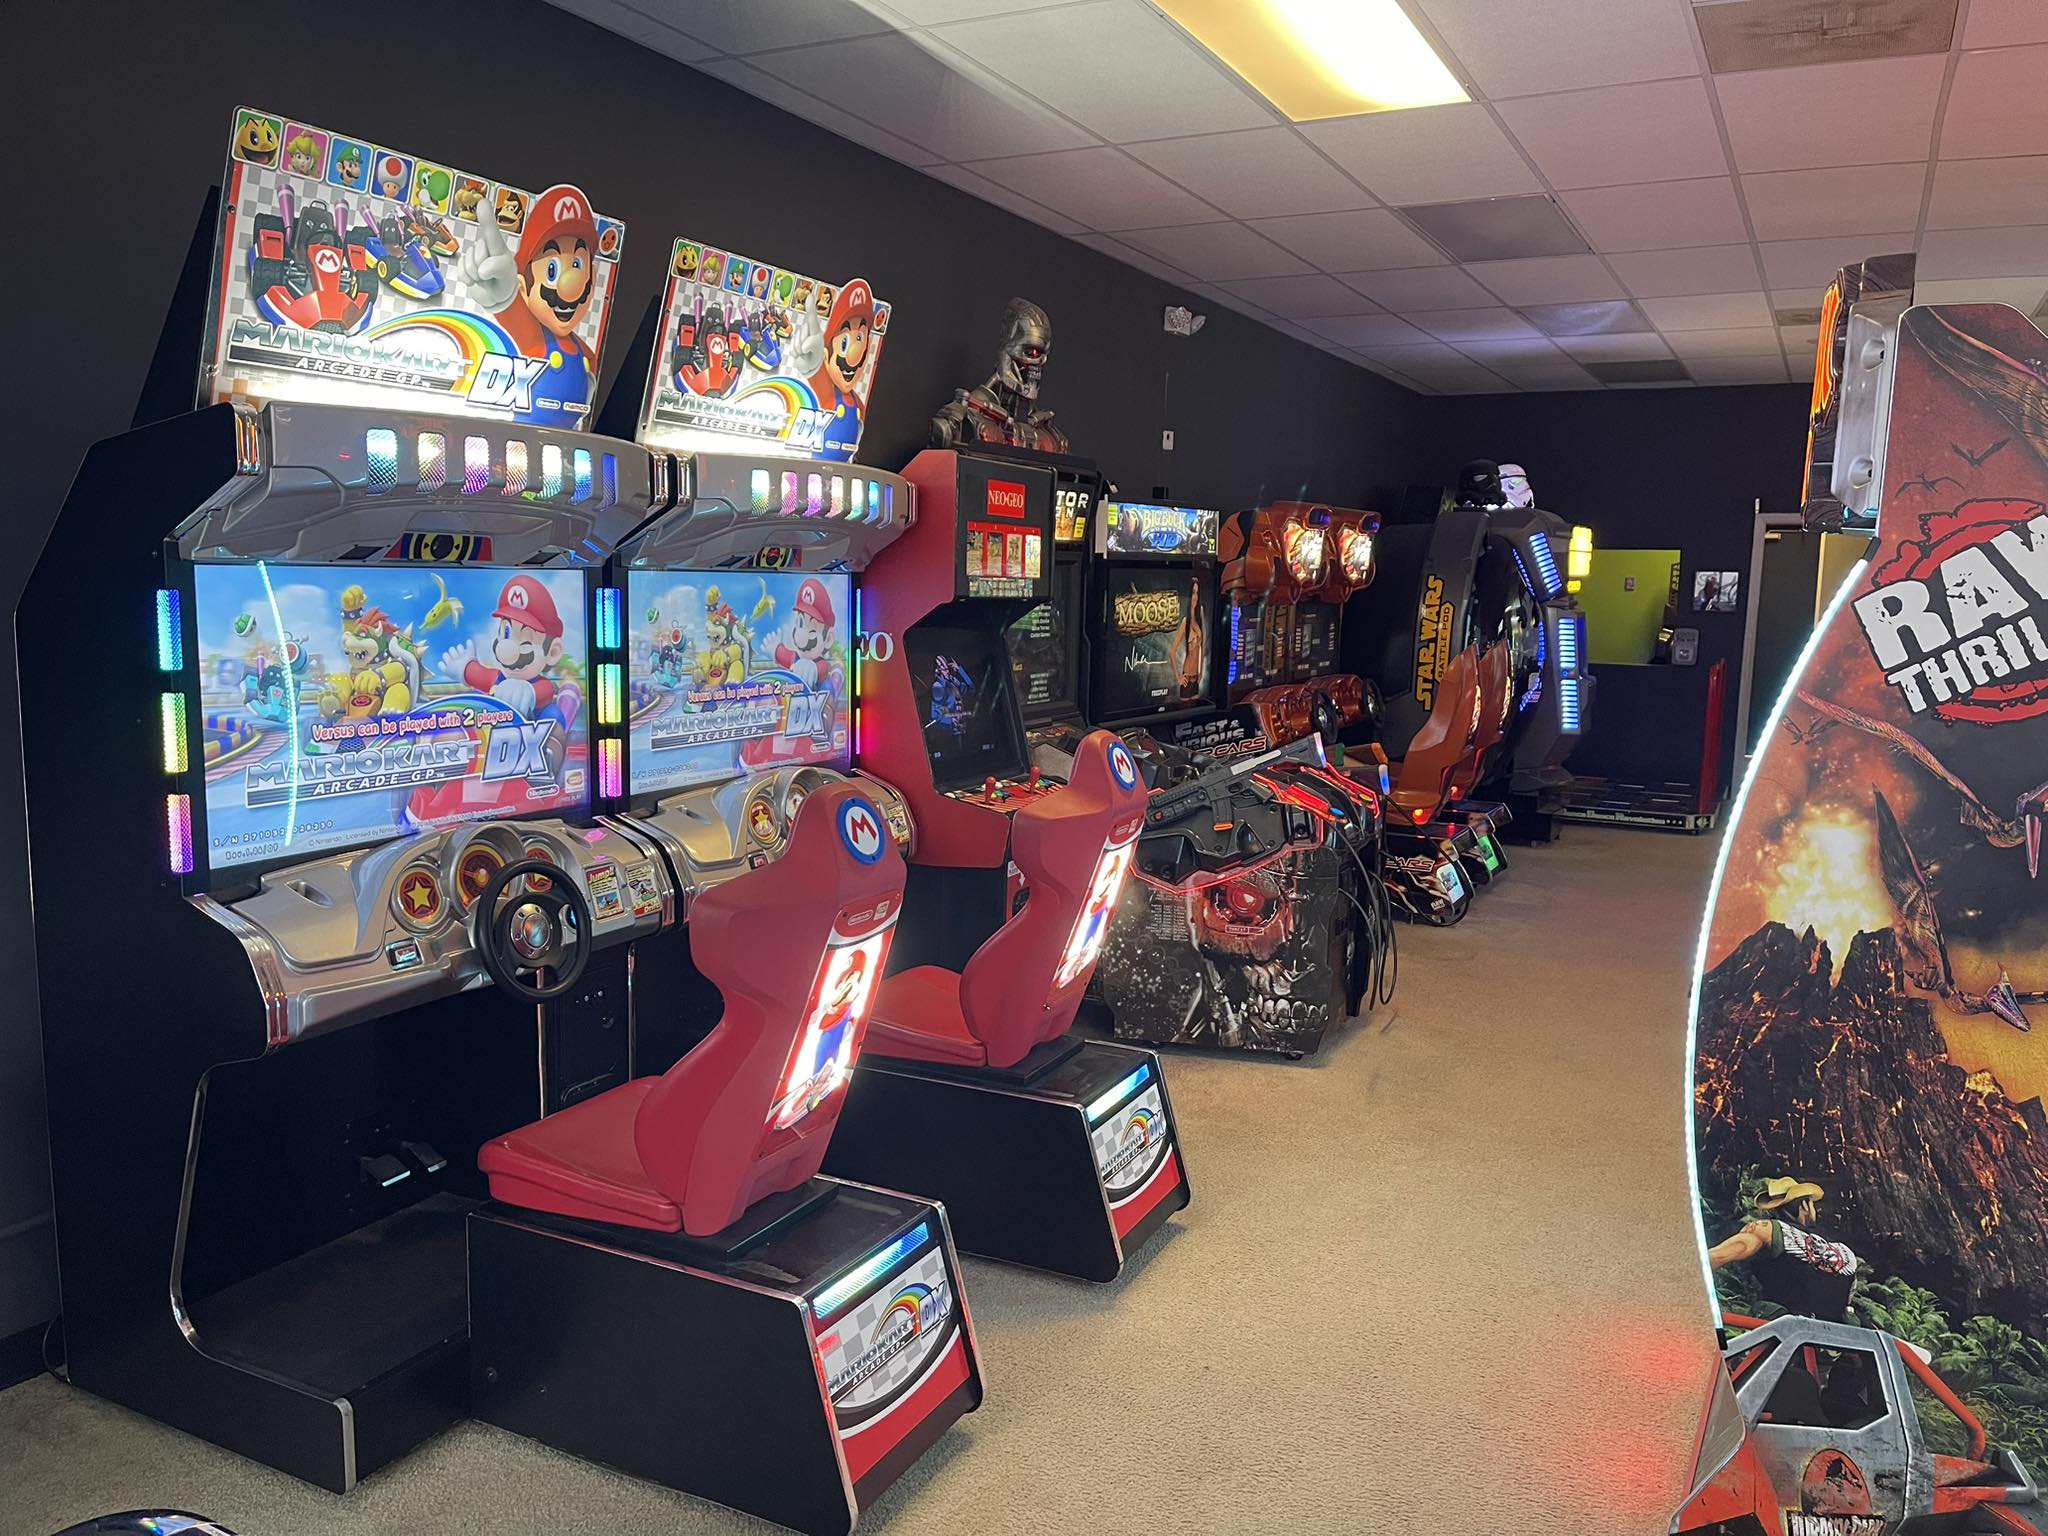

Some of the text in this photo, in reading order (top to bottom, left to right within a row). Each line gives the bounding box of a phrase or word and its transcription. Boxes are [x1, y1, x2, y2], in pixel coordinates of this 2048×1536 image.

[295, 357, 384, 380] ARCADE
[467, 351, 548, 411] DX
[1118, 596, 1178, 625] MOOSE
[1416, 575, 1443, 710] STAR WARS
[774, 681, 781, 694] 2
[312, 708, 514, 741] Versus can be played with 2 players
[785, 691, 829, 737] DX
[1175, 719, 1240, 738] FAST &
[482, 720, 556, 782] DX
[687, 729, 736, 744] ARCADE
[313, 773, 400, 796] ARCADE
[851, 812, 878, 845] M
[853, 1354, 886, 1386] ARCADE
